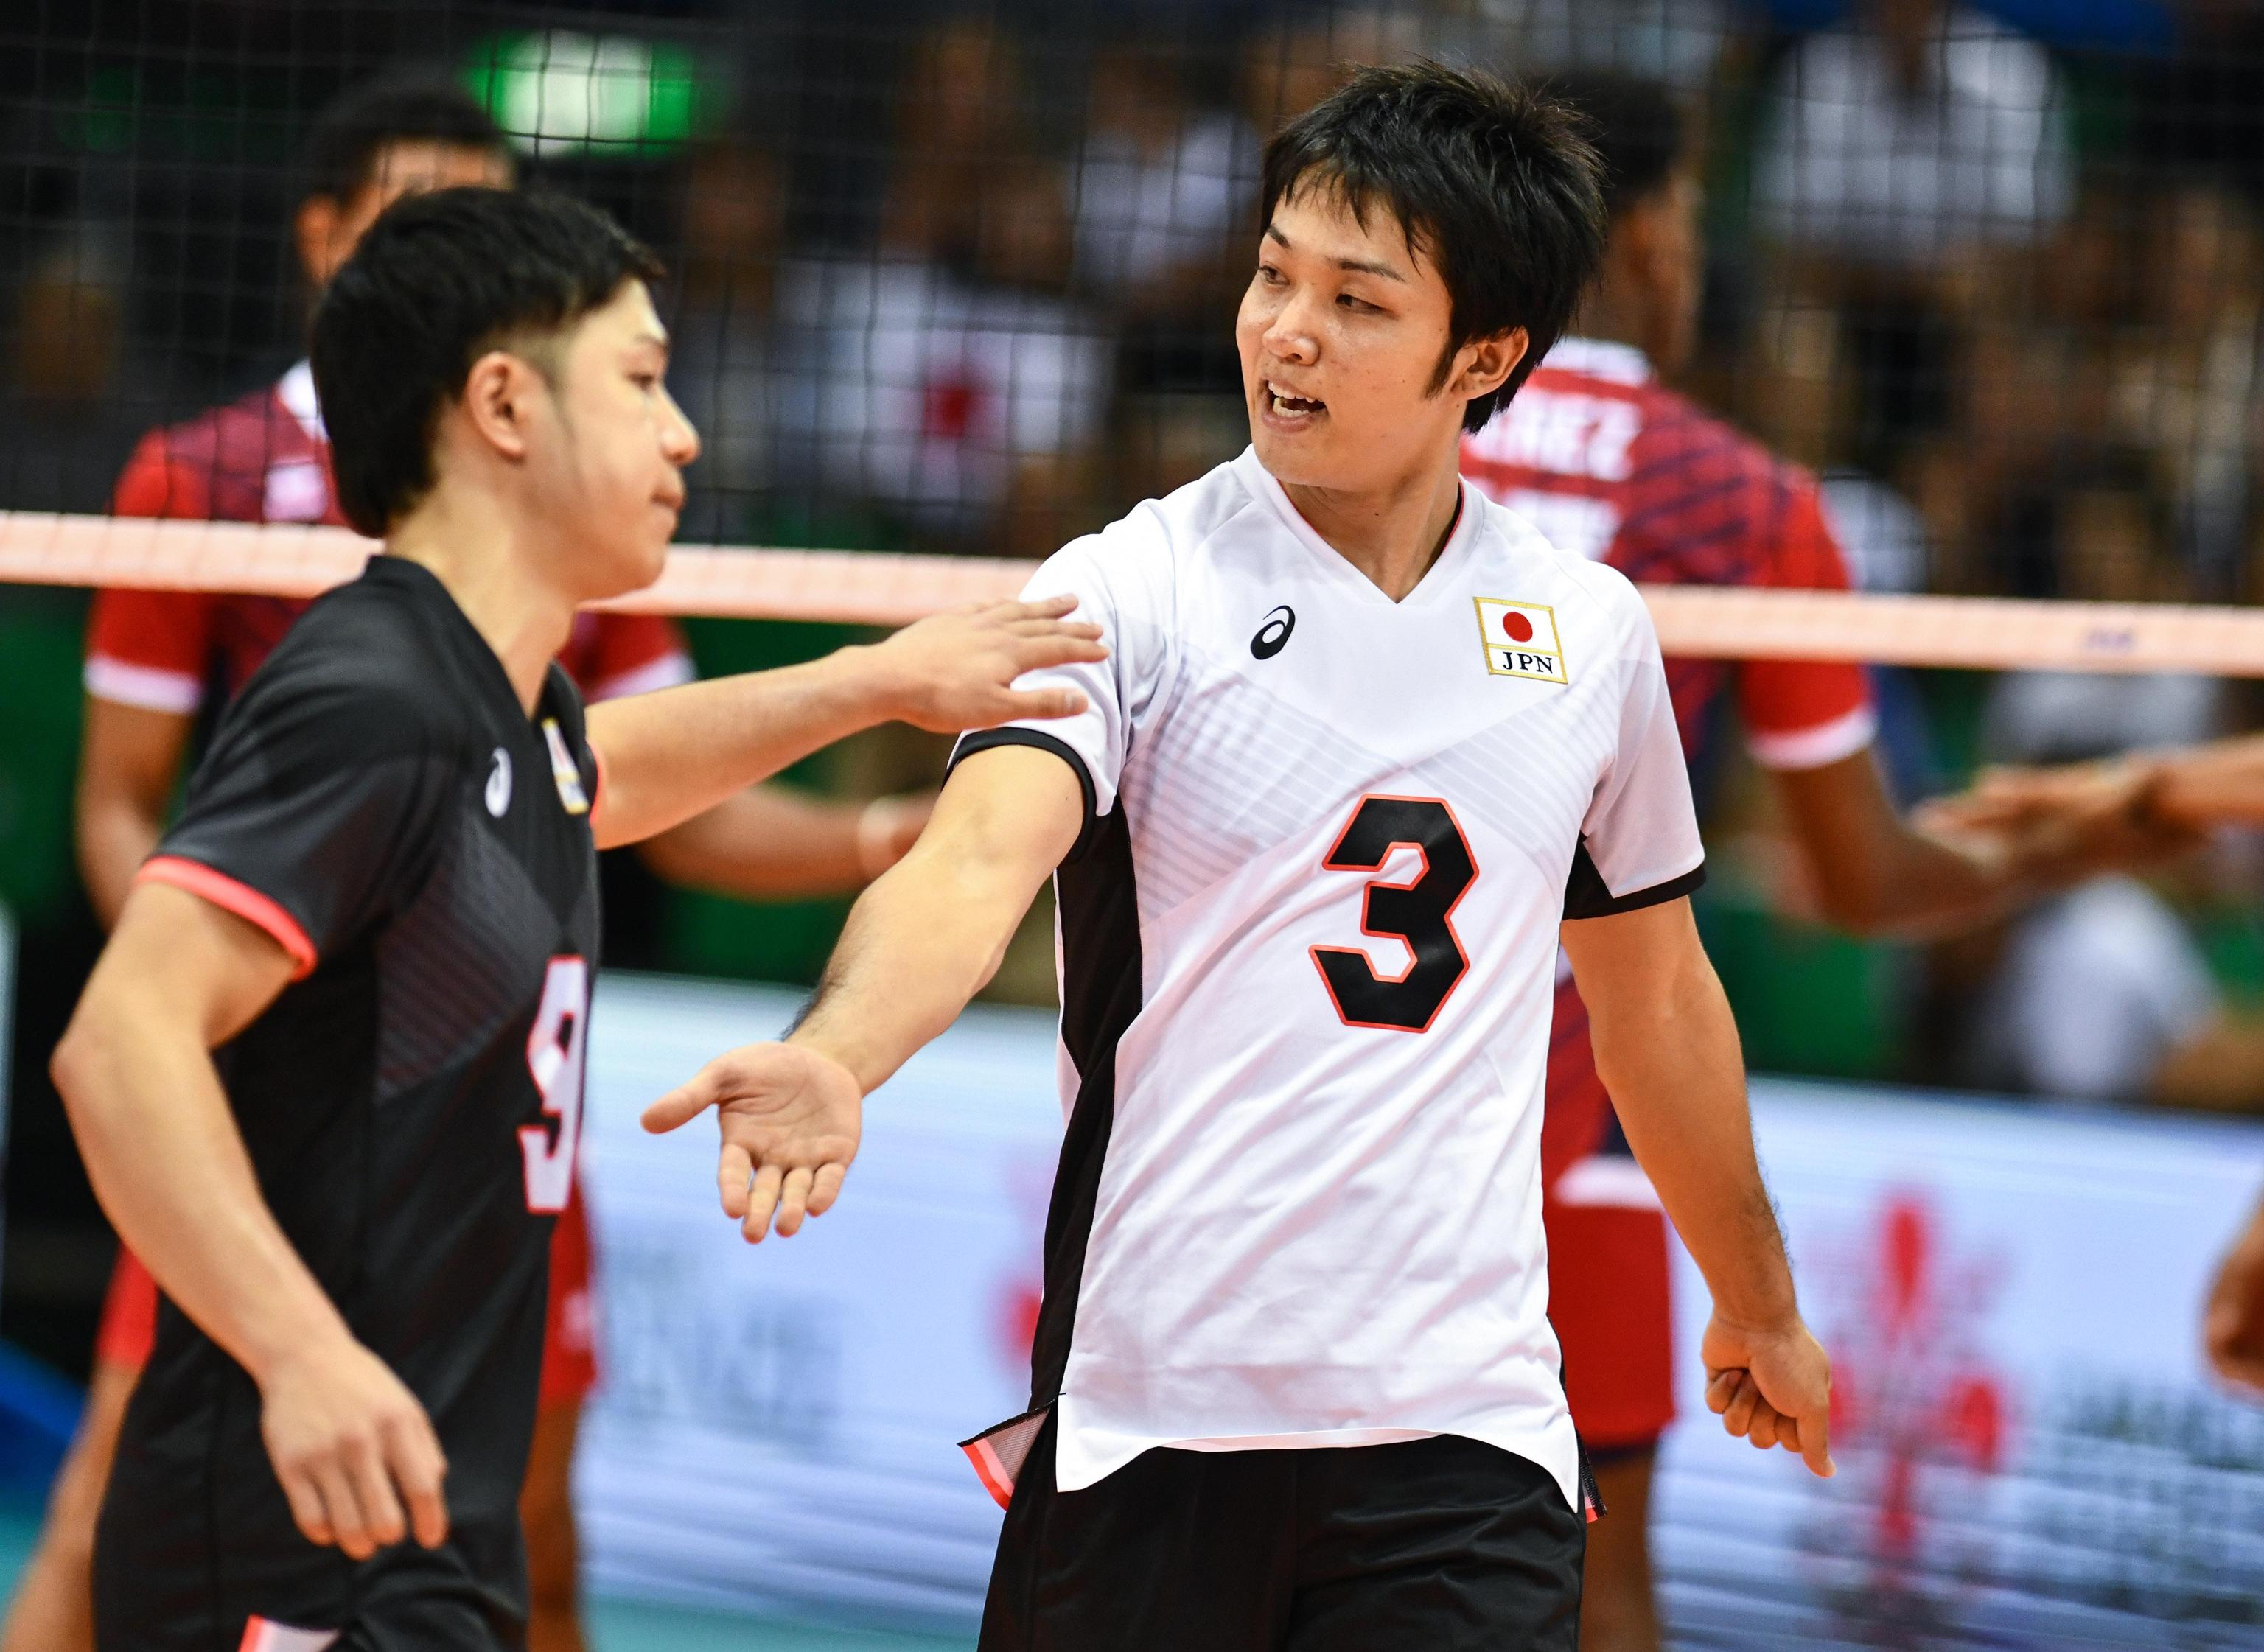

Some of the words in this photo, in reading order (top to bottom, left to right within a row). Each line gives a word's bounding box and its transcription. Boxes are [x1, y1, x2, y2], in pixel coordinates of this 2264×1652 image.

[1502, 651, 1553, 674] JPN
[1308, 793, 1480, 1034] 3
[517, 954, 587, 1216] 9
